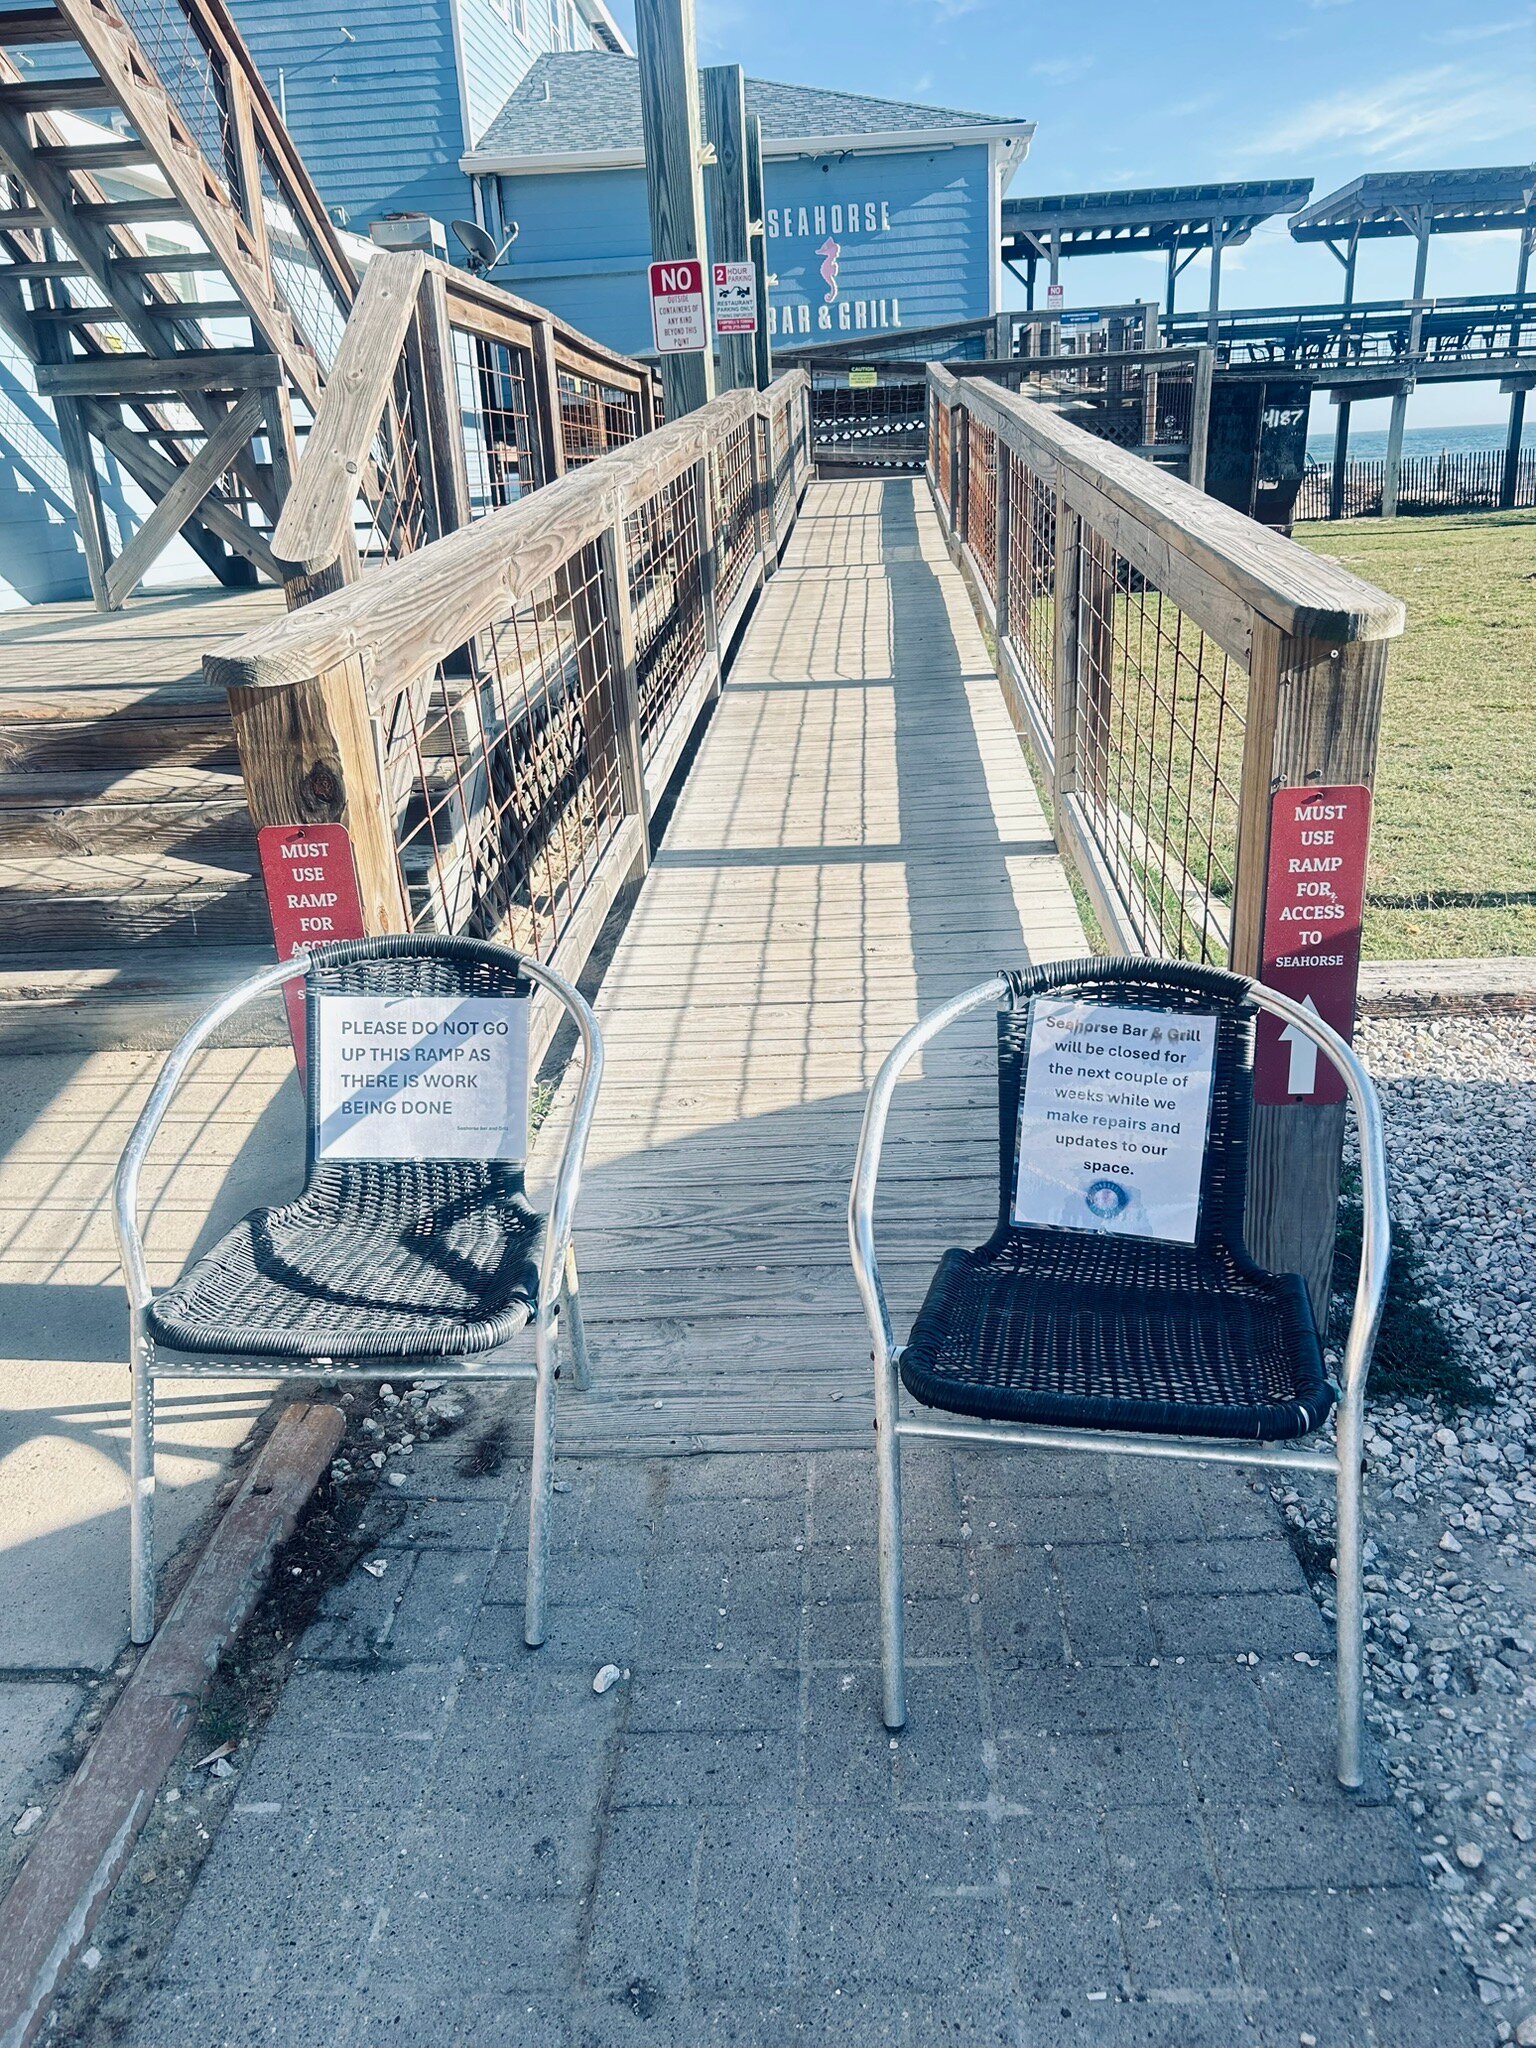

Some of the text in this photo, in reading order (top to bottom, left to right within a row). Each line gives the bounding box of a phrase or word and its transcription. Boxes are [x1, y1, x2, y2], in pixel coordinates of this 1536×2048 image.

[767, 201, 891, 238] SEAHORSE
[661, 266, 692, 292] NO
[716, 267, 747, 281] 2 HOUR
[1050, 286, 1061, 295] NO
[667, 295, 689, 304] OUTSIDE
[659, 304, 699, 315] CONTAINERS OF
[768, 298, 902, 334] BAR & GRILL
[667, 316, 692, 325] ANY KIND
[664, 328, 684, 336] BEYOND
[674, 337, 689, 346] POINT
[1263, 408, 1304, 428] 4187
[1294, 805, 1347, 822] MUST
[1301, 830, 1335, 846] USE
[280, 842, 329, 859] MUST
[1288, 857, 1343, 873] RAMP
[292, 867, 325, 882] USE
[1296, 882, 1332, 897] FOR
[287, 893, 338, 908] RAMP
[1279, 905, 1345, 921] ACCESS
[300, 917, 334, 932] FOR
[1299, 931, 1322, 945] TO
[1275, 955, 1344, 968] SEAHORSE
[341, 1021, 509, 1035] PLEASE DO NOT GO
[1046, 1016, 1201, 1042] Seahorse Bar & Grill
[341, 1048, 491, 1062] UP THIS RAMP AS
[1055, 1041, 1187, 1064] will be closed for
[341, 1074, 478, 1088] THERE IS WORK
[1049, 1062, 1188, 1087] the next couple of
[1055, 1088, 1176, 1110] weeks while we
[341, 1101, 452, 1115] BEING DONE
[1046, 1110, 1181, 1135] make repairs and
[1055, 1134, 1168, 1156] updates to our
[1083, 1160, 1134, 1175] space.
